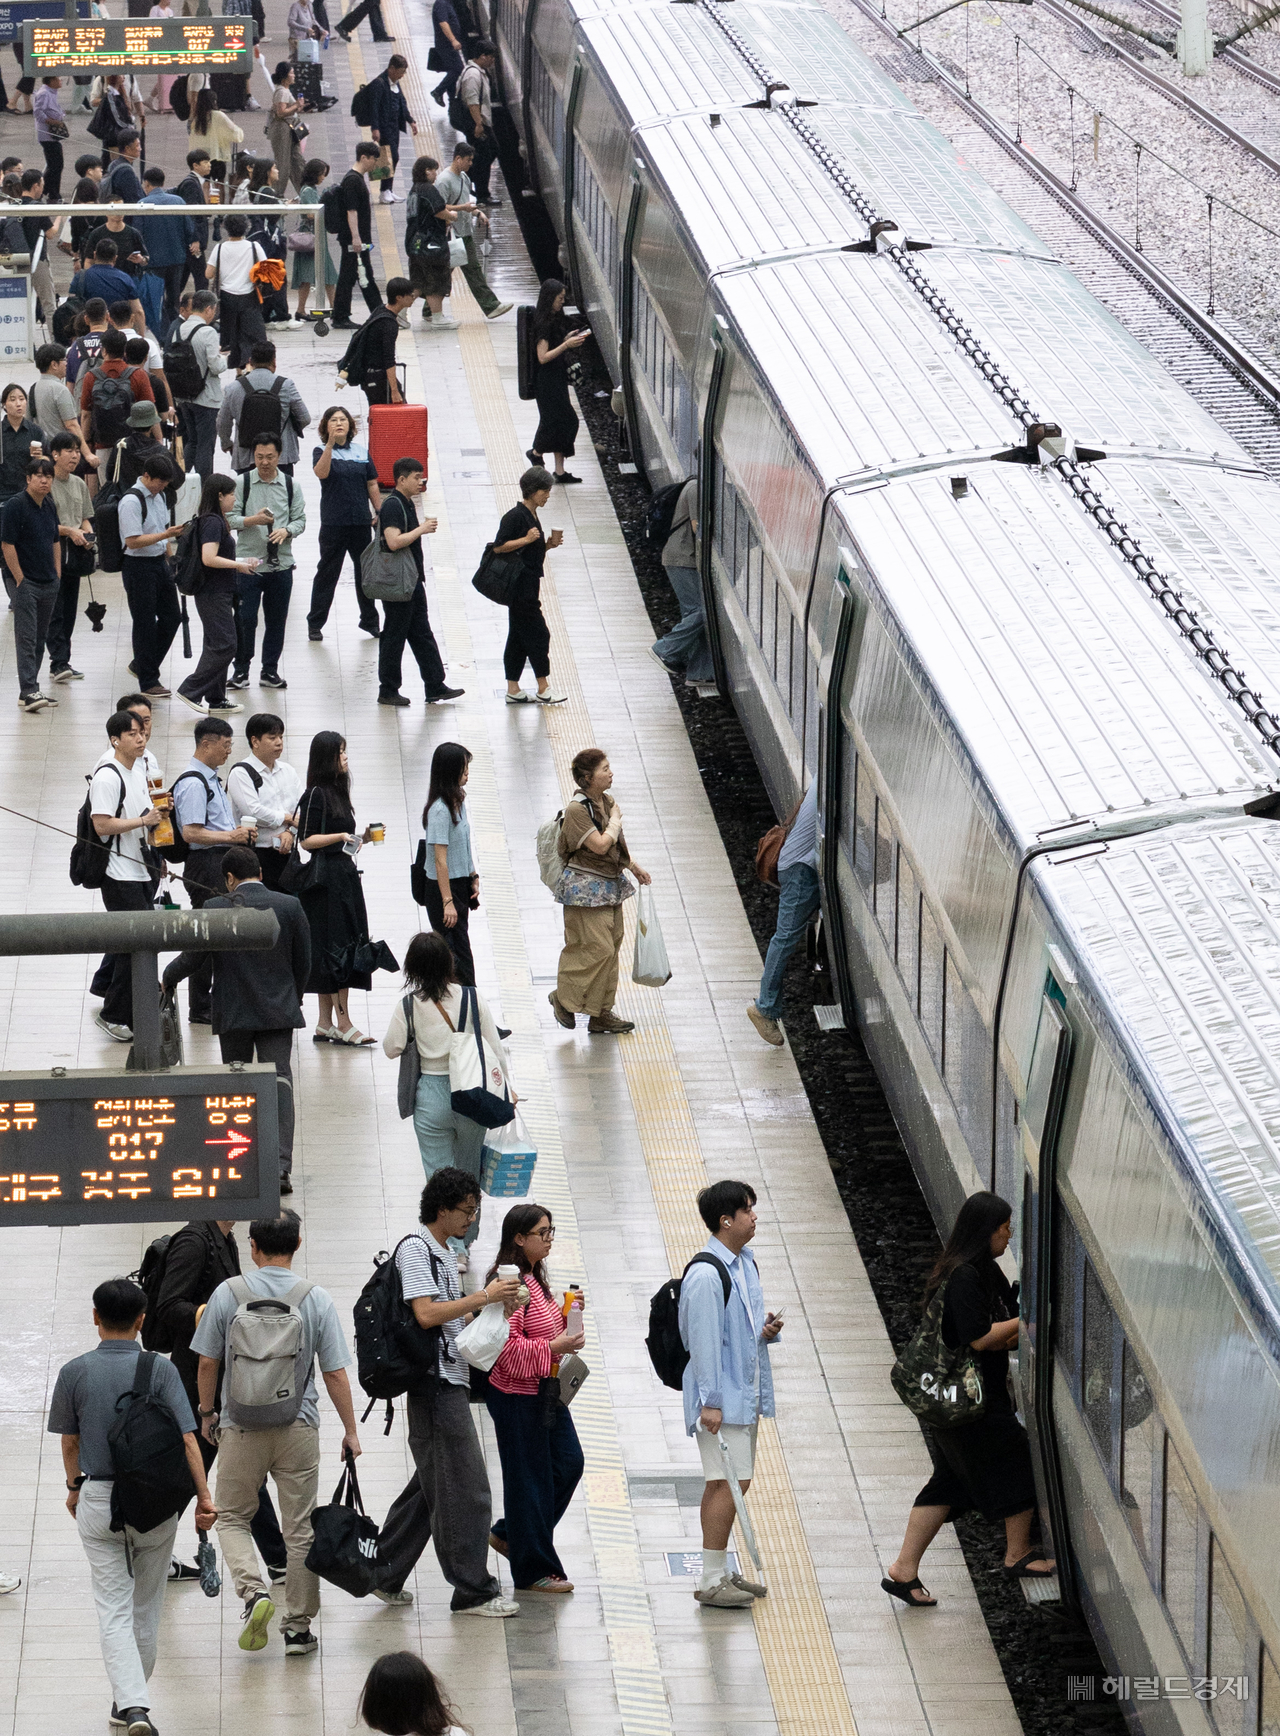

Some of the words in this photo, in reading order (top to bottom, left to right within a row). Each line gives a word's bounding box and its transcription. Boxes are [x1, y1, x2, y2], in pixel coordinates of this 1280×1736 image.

[188, 38, 211, 51] 017
[109, 1131, 164, 1161] 017
[920, 1372, 958, 1403] CAM
